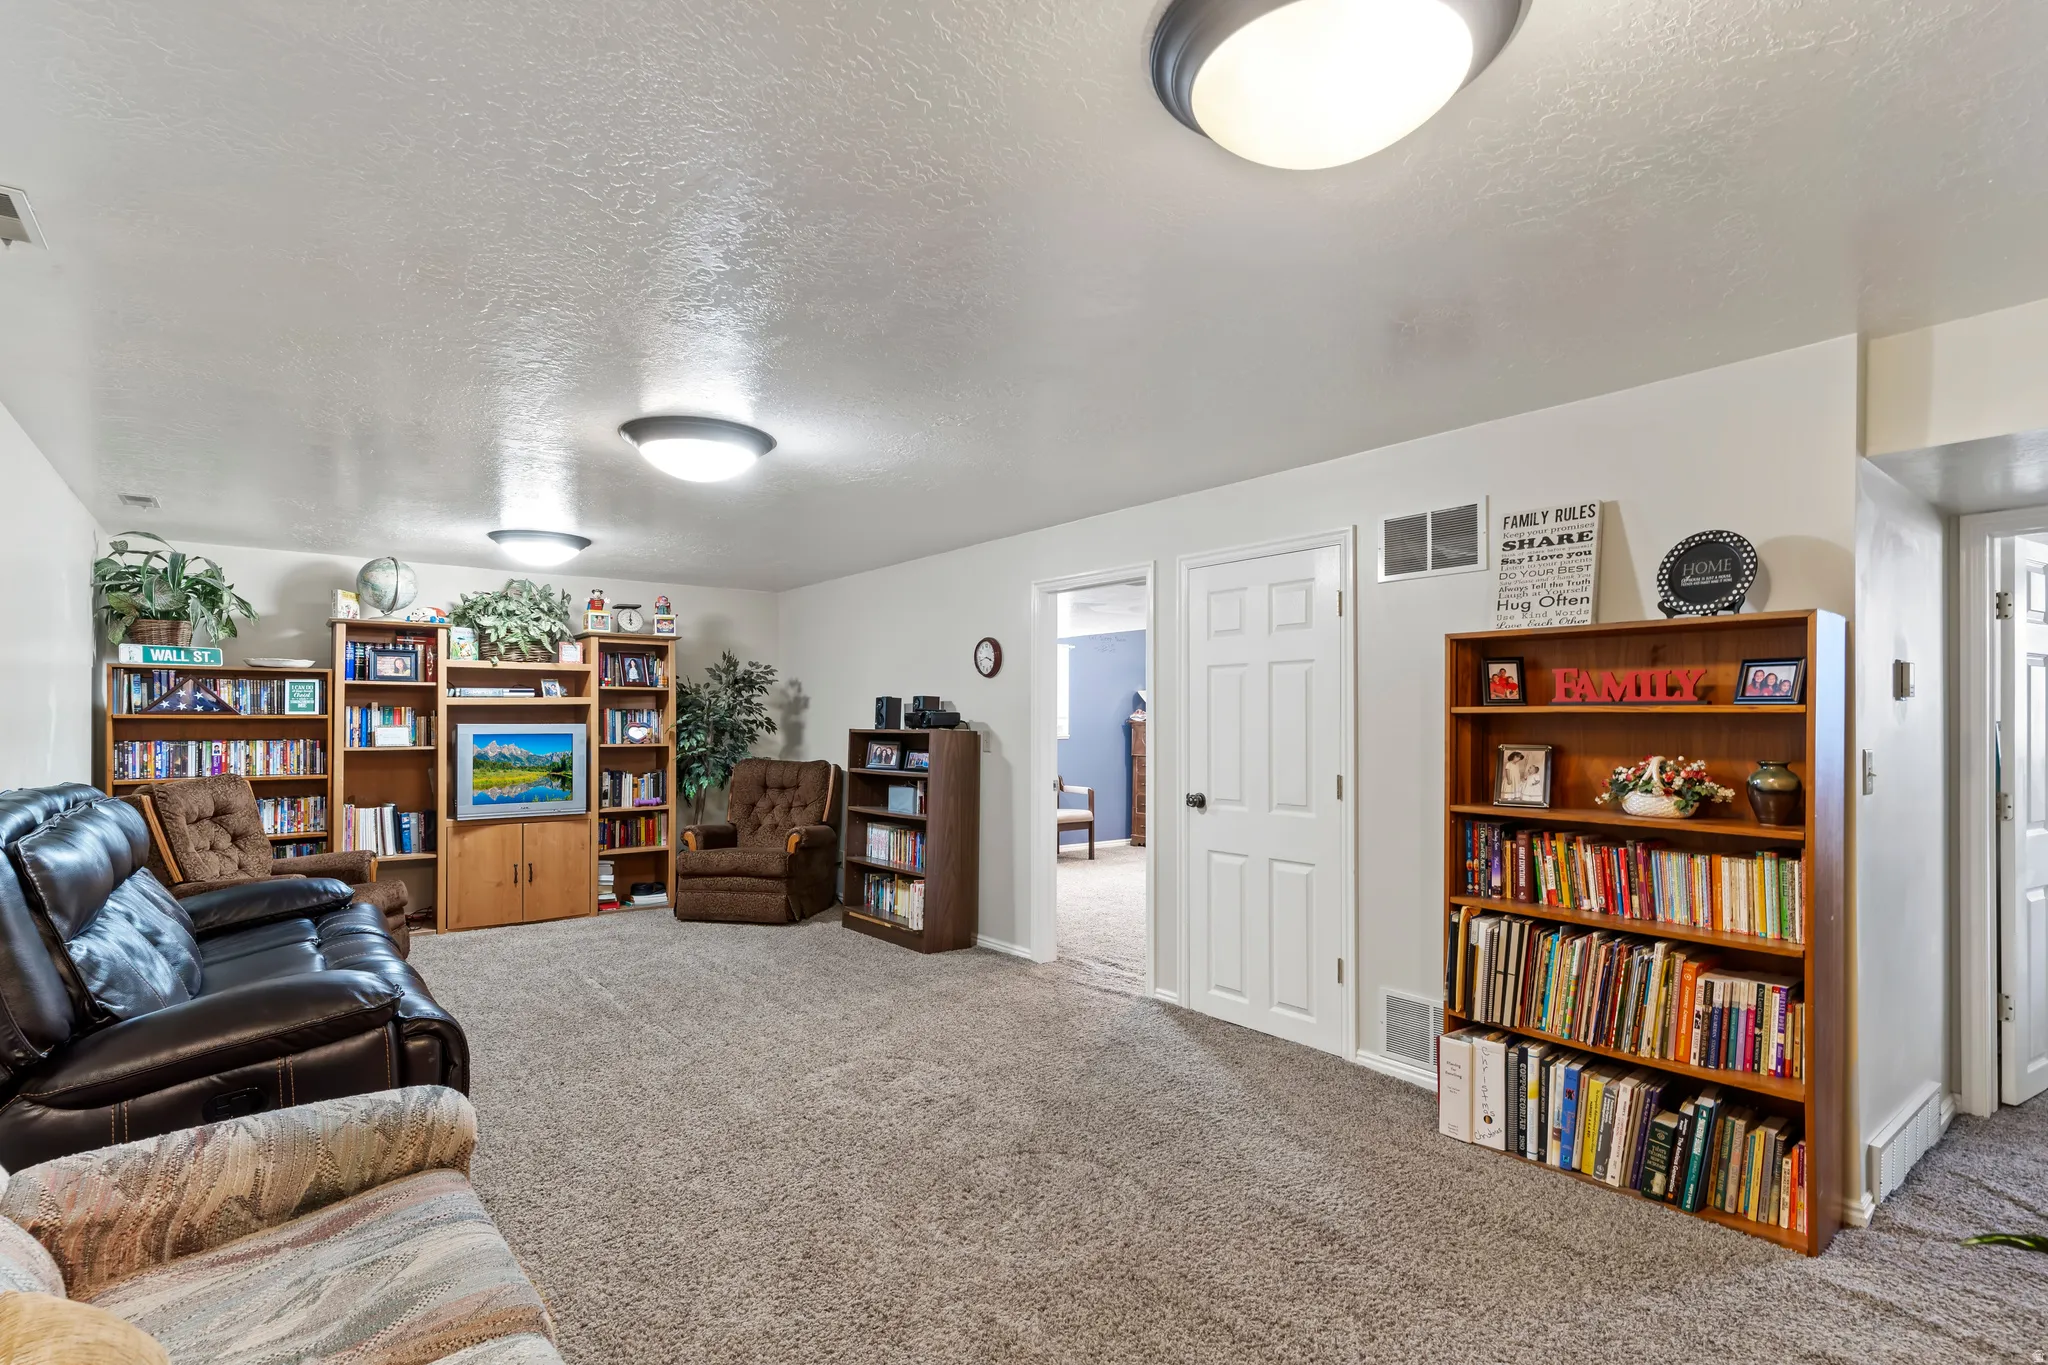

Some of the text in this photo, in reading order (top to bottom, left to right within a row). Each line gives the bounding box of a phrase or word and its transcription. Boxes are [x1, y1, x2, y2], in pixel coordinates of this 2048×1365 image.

[1503, 504, 1596, 530] FAMILY RULES
[1503, 522, 1595, 539] Keep your promises
[1502, 530, 1594, 552] SHARE
[1501, 550, 1592, 566] Say I love you
[1501, 564, 1524, 572] Listen
[1537, 561, 1558, 569] your
[1560, 557, 1592, 567] parents
[1520, 568, 1554, 578] YOUR
[1558, 564, 1591, 574] BEST
[1683, 558, 1732, 576] HOME
[1498, 590, 1528, 600] Laugh
[1545, 585, 1588, 595] Yourself
[1499, 585, 1528, 593] Always
[1531, 582, 1546, 590] Tell
[1567, 578, 1591, 586] Truth
[1497, 593, 1590, 613] Hug Often
[1522, 611, 1548, 619] Kind
[1555, 608, 1589, 617] Words
[1496, 616, 1588, 630] Love Each Other
[150, 648, 214, 663] WALL ST.
[1551, 668, 1707, 702] FAMILY
